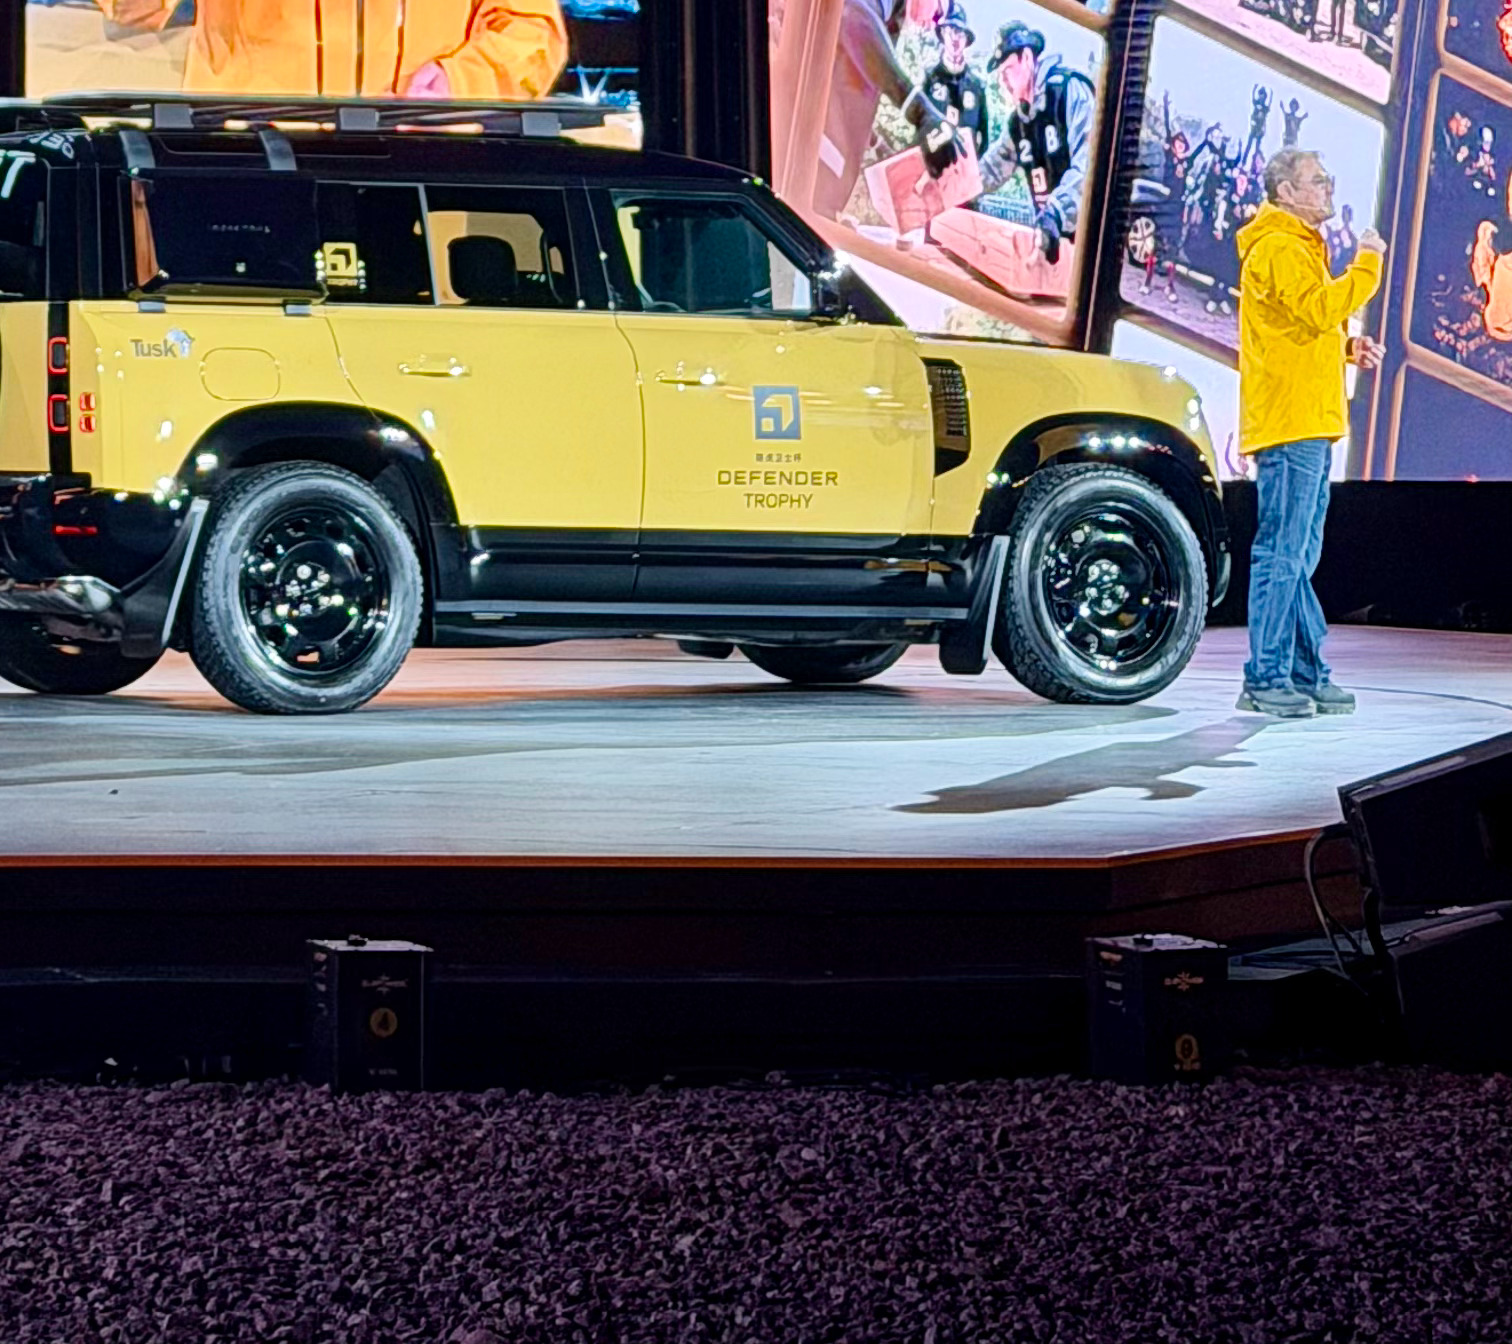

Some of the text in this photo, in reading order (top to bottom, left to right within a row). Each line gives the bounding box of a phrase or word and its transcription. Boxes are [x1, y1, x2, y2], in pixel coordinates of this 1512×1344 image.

[129, 338, 177, 359] Tusk
[717, 470, 839, 487] DEFENDER
[743, 493, 814, 510] TROPHY
